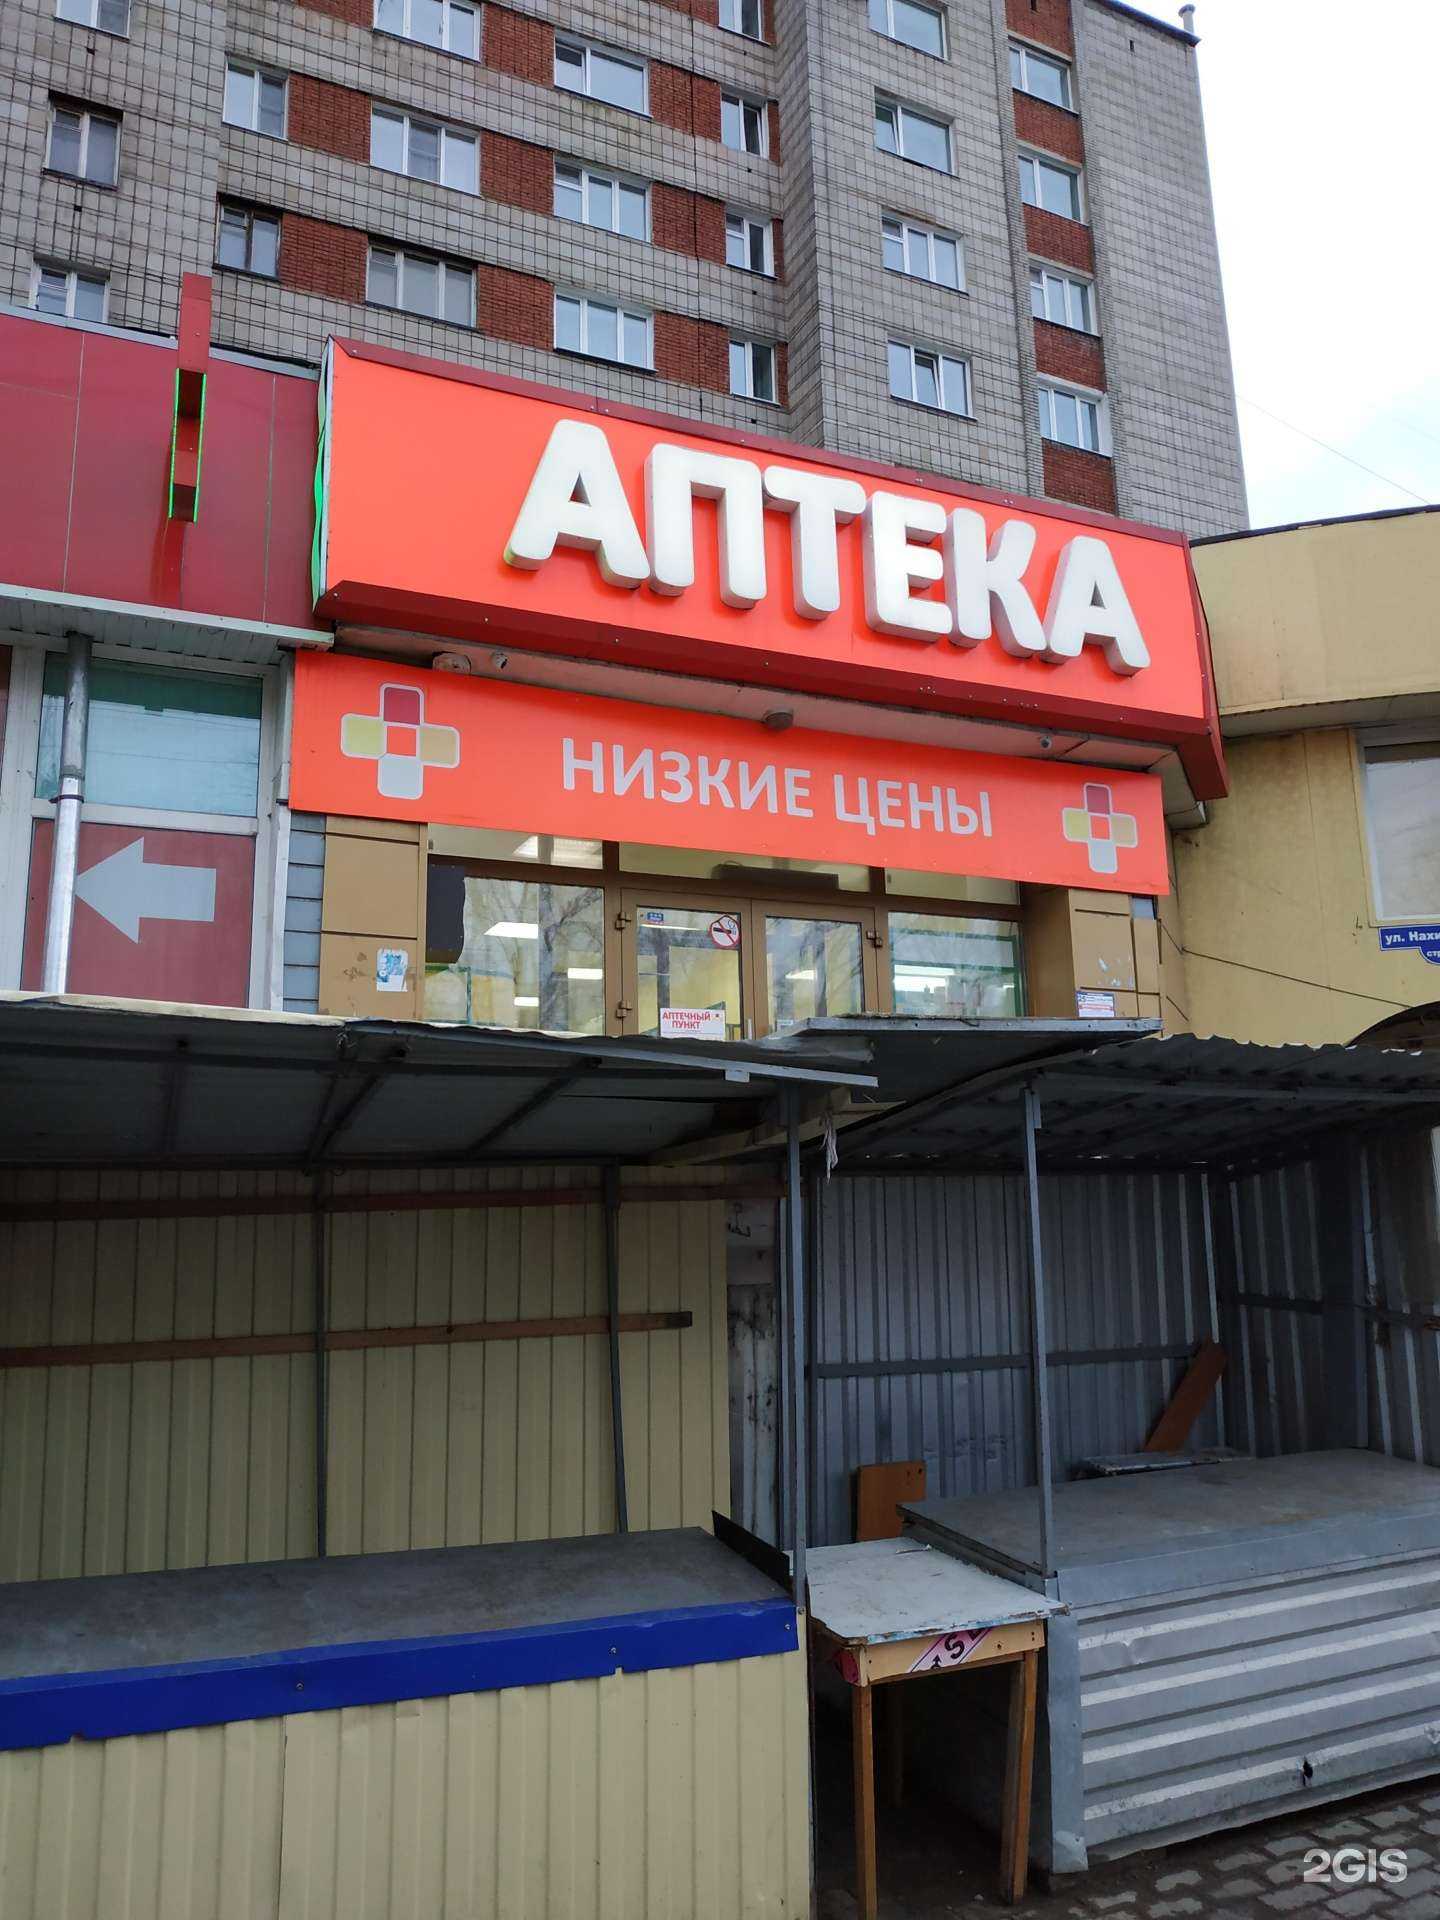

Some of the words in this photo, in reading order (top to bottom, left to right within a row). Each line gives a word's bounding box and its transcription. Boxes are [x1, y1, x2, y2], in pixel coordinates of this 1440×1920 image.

[503, 418, 1151, 676] АПТЕКА
[562, 737, 813, 818] НИЗКИЕ
[833, 774, 993, 837] ЦЕНЫ
[1385, 934, 1405, 945] ул.
[662, 1011, 711, 1022] АПТЕЧНЫЙ
[671, 1020, 701, 1029] ПУНКТ
